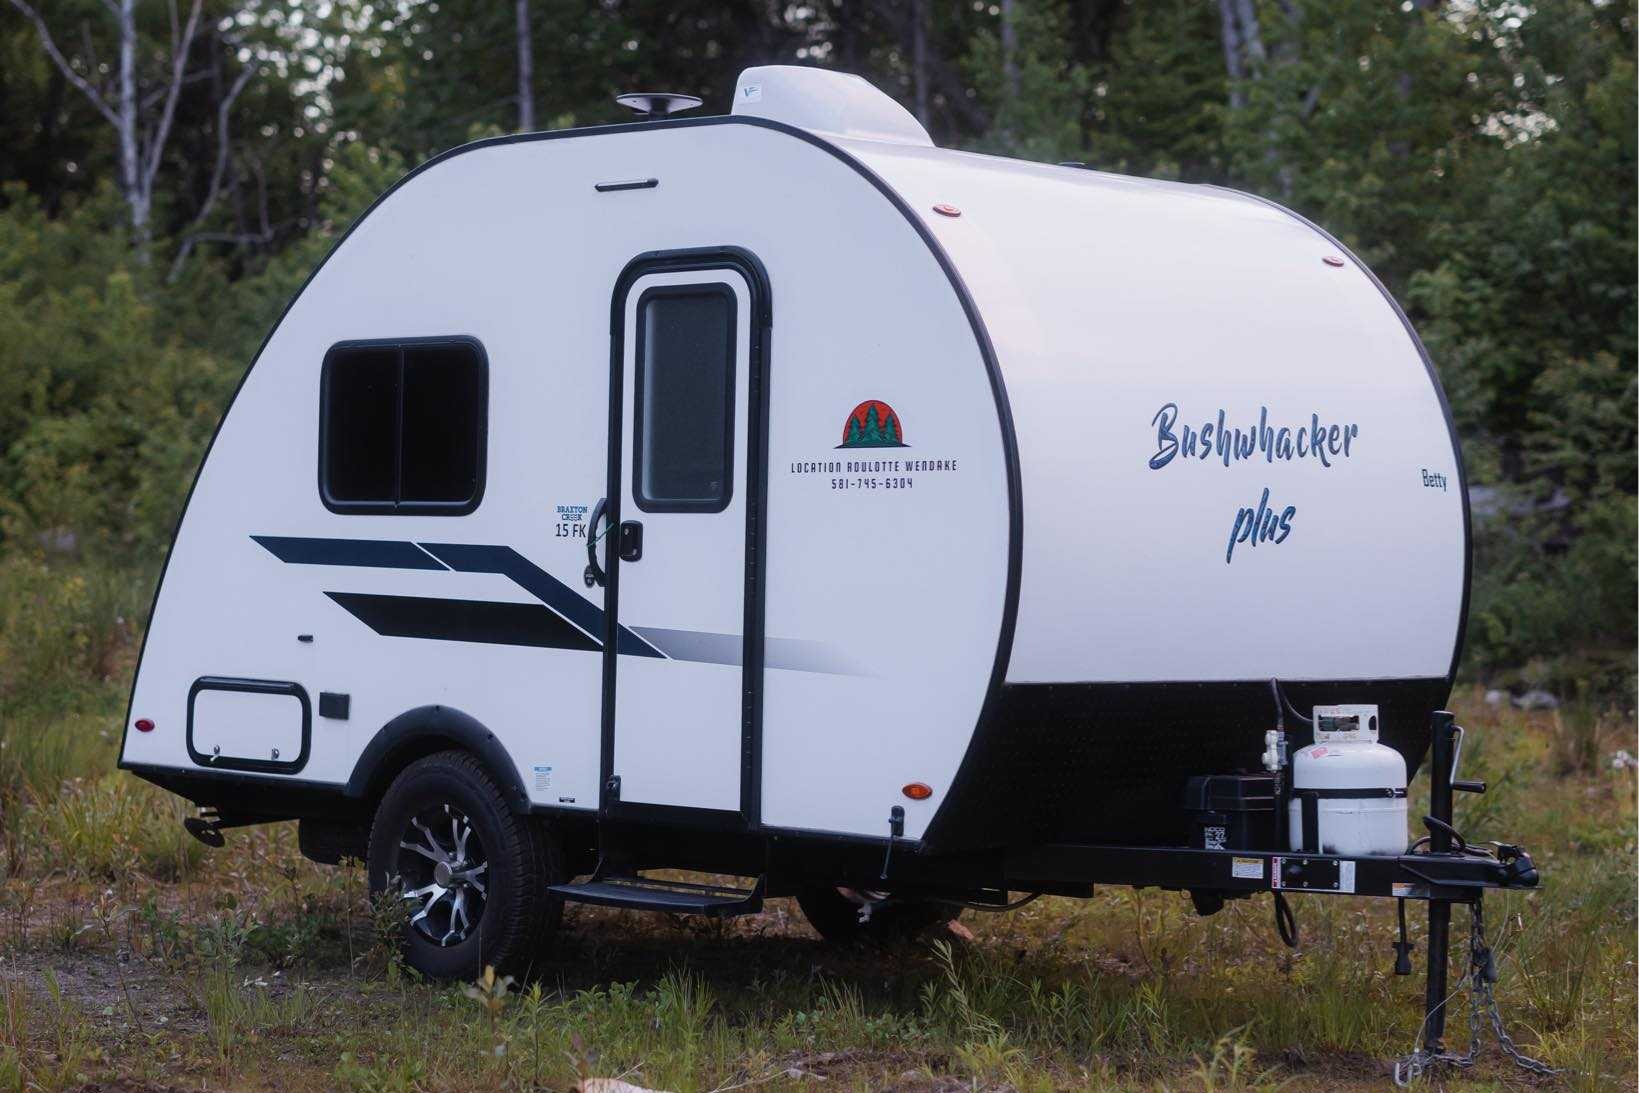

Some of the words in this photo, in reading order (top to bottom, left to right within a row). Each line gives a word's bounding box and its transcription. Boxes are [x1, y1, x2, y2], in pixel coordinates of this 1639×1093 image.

[1149, 402, 1359, 470] Bushwhacker
[791, 462, 841, 474] LOCATION
[847, 461, 899, 473] ROULOTTE
[905, 460, 957, 472] WENDAKE
[831, 478, 913, 489] 581-745-6304
[1421, 469, 1448, 492] Betty
[555, 523, 569, 537] 15
[572, 524, 586, 538] FK
[1226, 487, 1296, 564] plus
